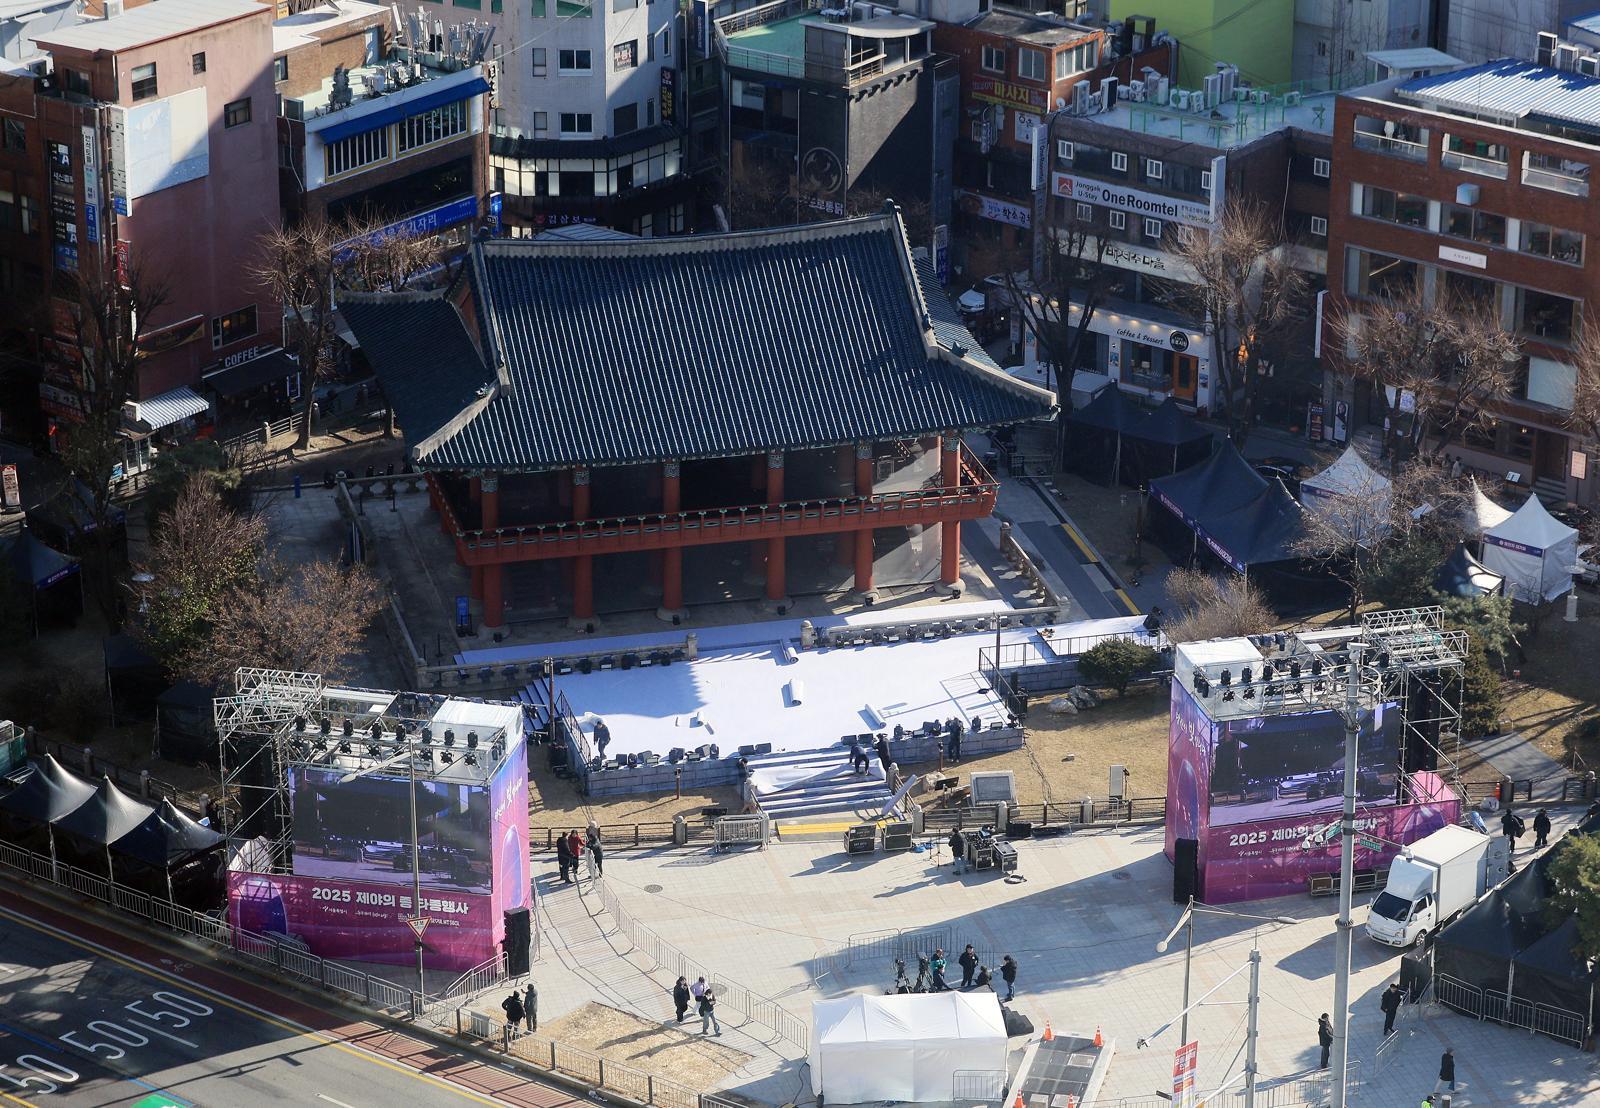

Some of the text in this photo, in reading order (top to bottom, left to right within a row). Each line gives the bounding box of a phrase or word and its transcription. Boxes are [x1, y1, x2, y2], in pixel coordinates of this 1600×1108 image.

[994, 81, 1029, 104] 마사지
[1075, 180, 1101, 193] Jonggak
[1077, 190, 1098, 202] U-Stay
[1116, 327, 1135, 338] Coffee
[1142, 334, 1164, 346] Dessert
[224, 346, 260, 368] COFFEE
[1229, 831, 1267, 847] 2025
[1271, 824, 1309, 842] 제야의
[311, 886, 469, 915] 2025 제야의 종 타종행사
[125, 990, 215, 1029] 50
[59, 1019, 149, 1061] 50
